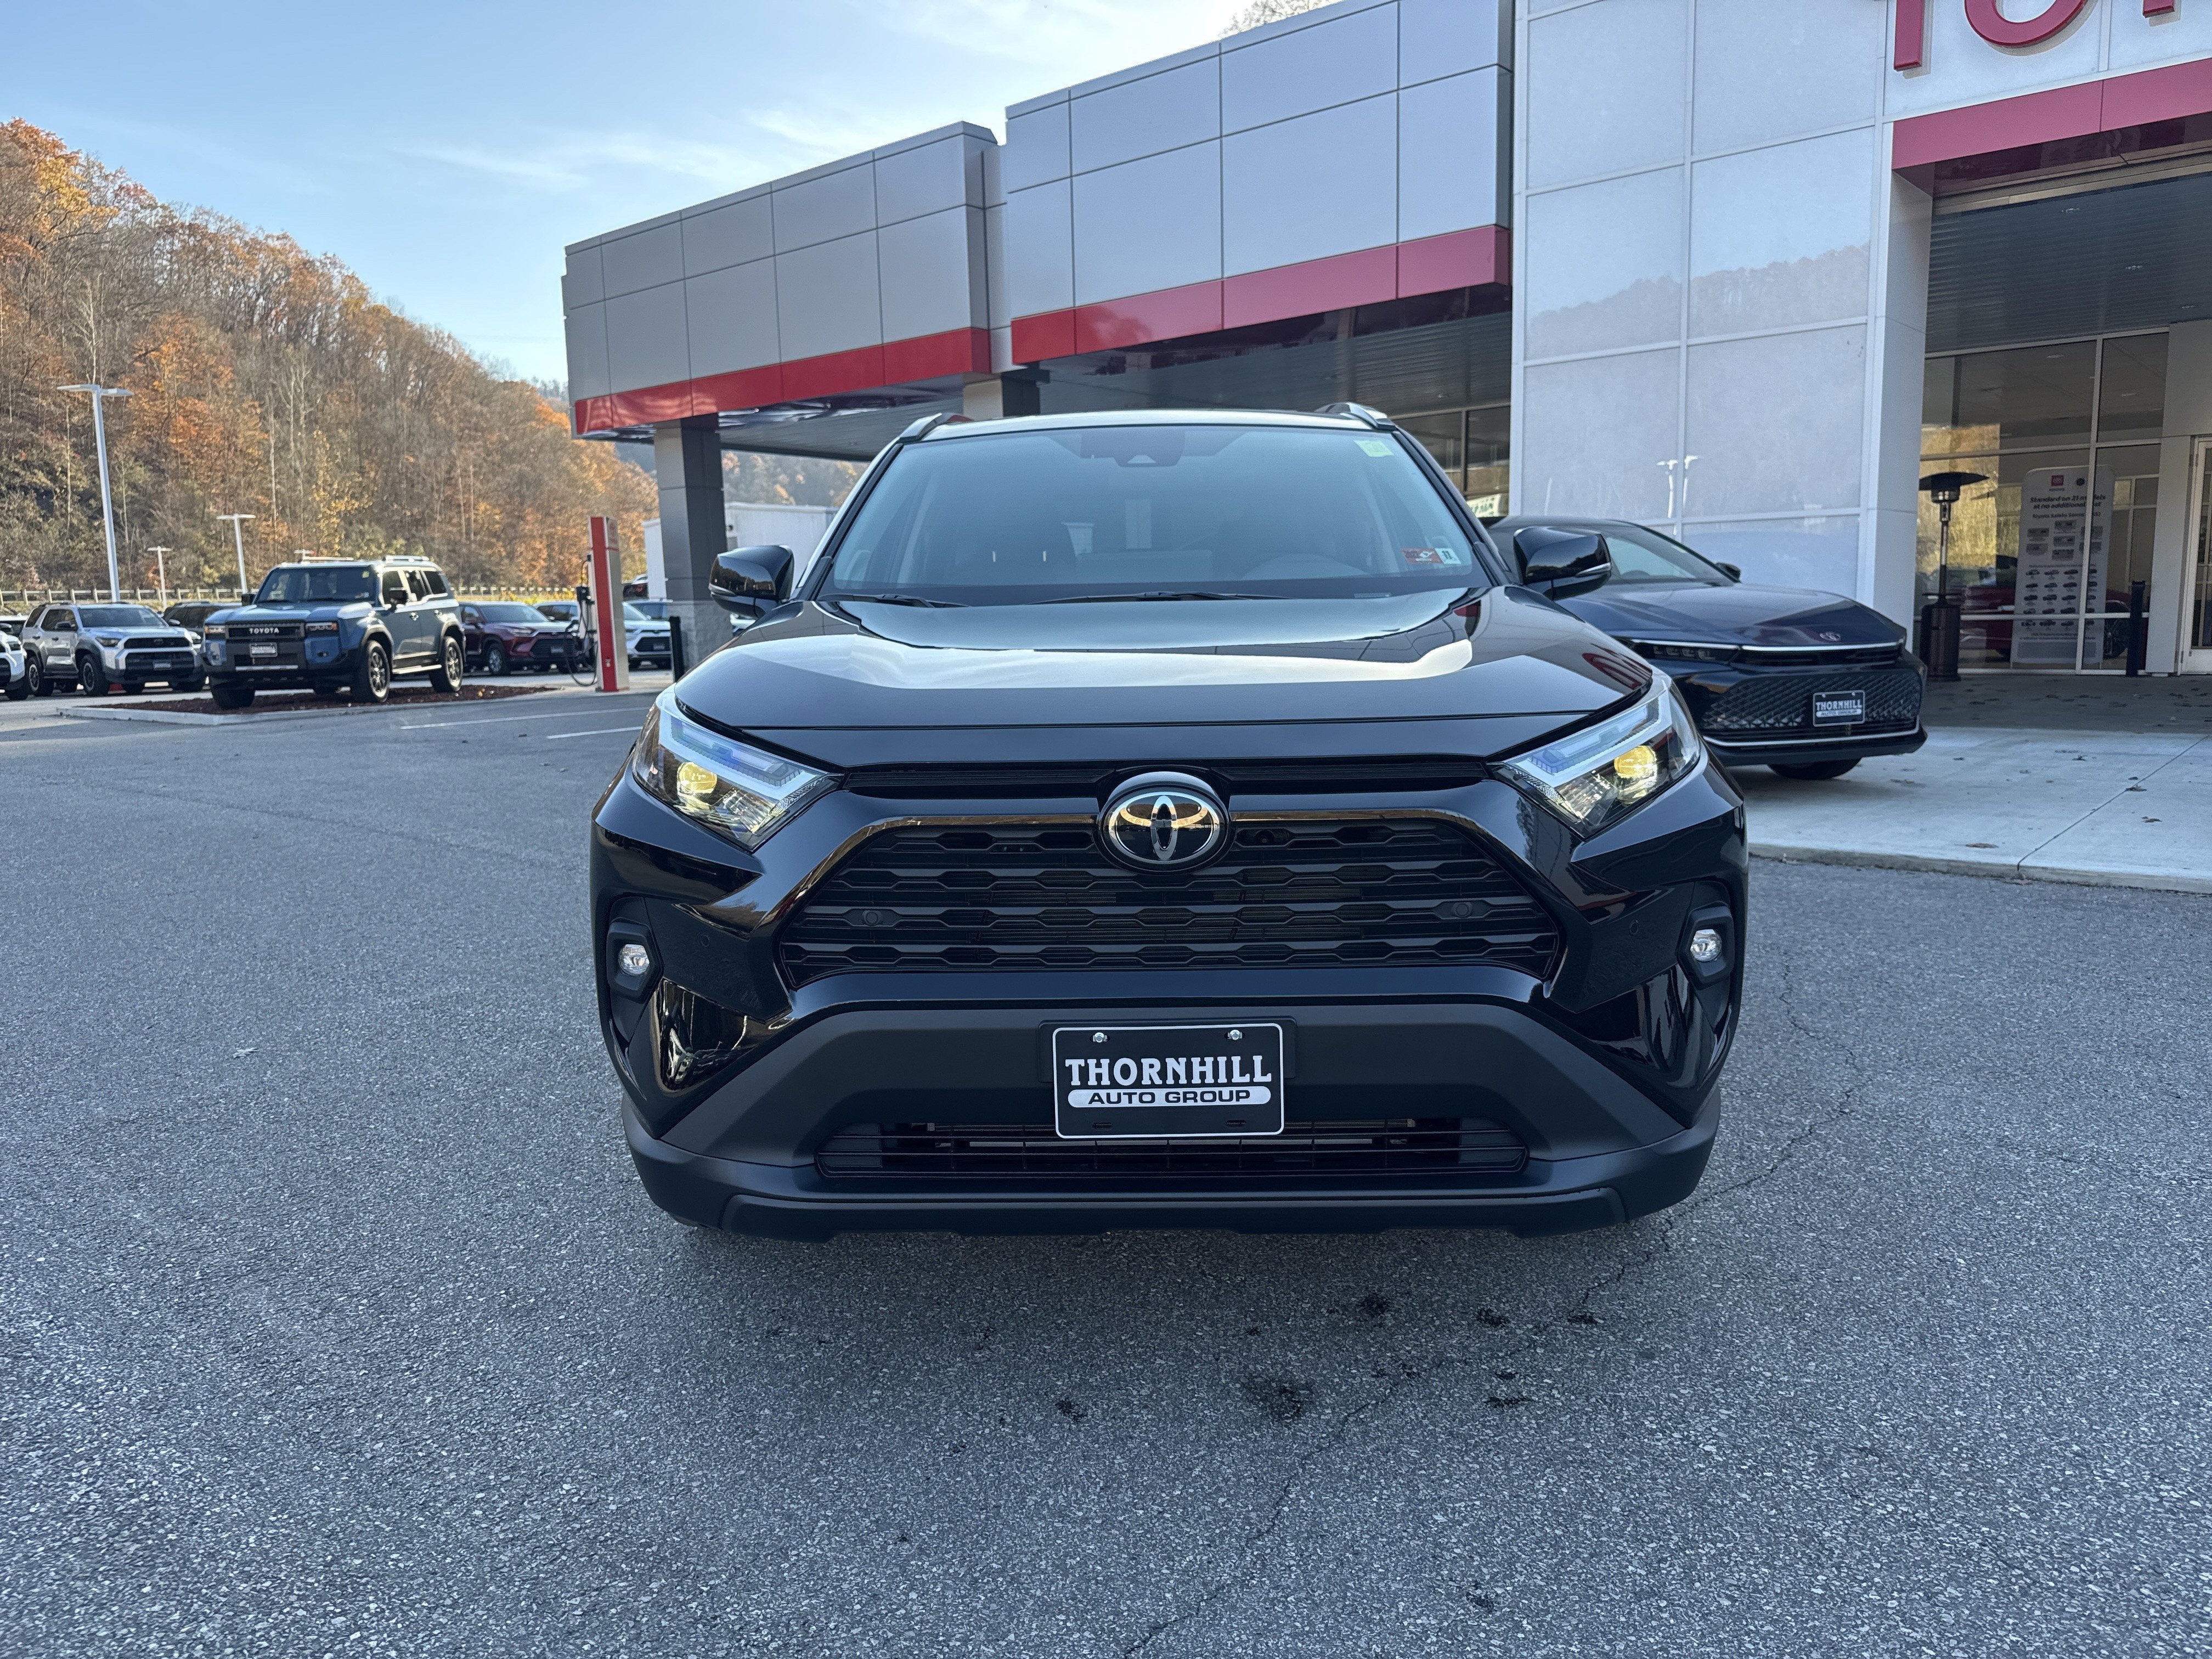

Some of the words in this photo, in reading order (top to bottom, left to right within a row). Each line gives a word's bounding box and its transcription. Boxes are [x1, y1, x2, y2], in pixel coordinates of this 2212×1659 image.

[1441, 550, 1453, 560] 11
[1815, 699, 1863, 711] THORNHILL
[1065, 1055, 1272, 1086] THORNHILL
[1087, 1092, 1153, 1105] AUTO
[1164, 1089, 1250, 1104] GROUP
